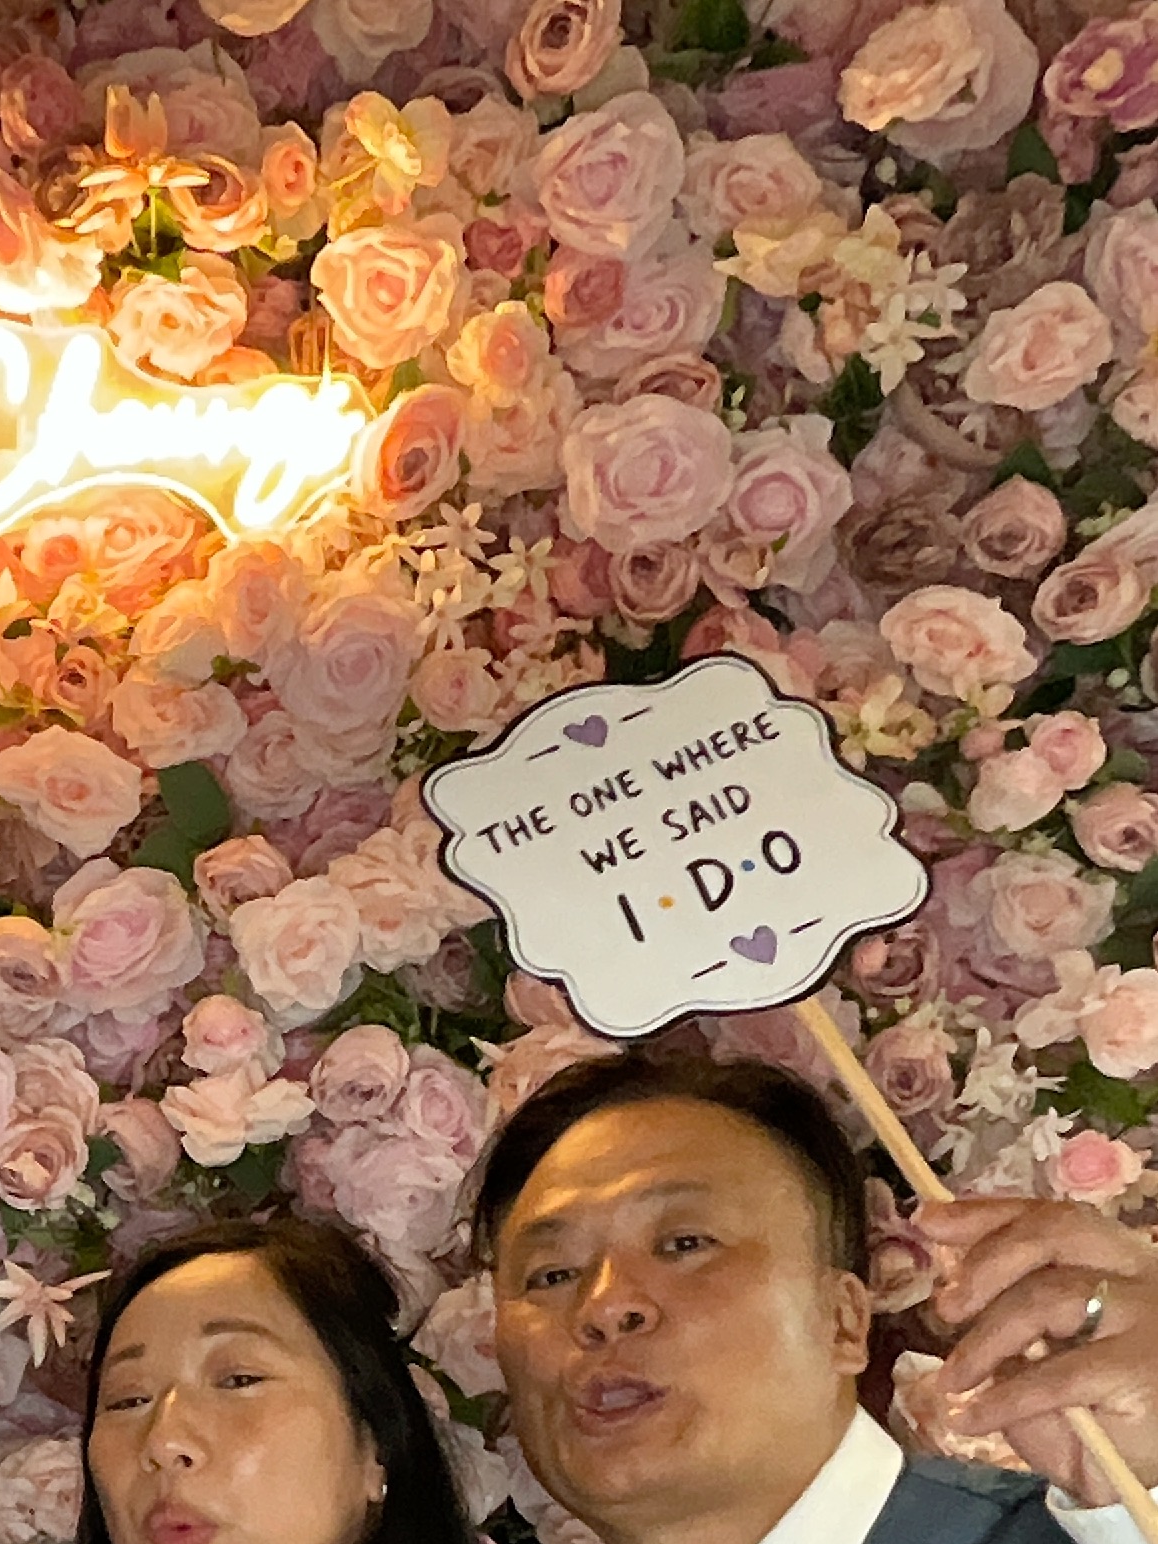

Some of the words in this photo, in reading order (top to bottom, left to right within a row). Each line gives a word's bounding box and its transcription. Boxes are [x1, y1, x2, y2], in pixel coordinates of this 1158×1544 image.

[476, 805, 556, 854] THE
[570, 769, 643, 817] ONE
[652, 710, 781, 781] WHERE
[580, 827, 646, 874] WE
[661, 784, 752, 841] SAID
[617, 893, 645, 943] I
